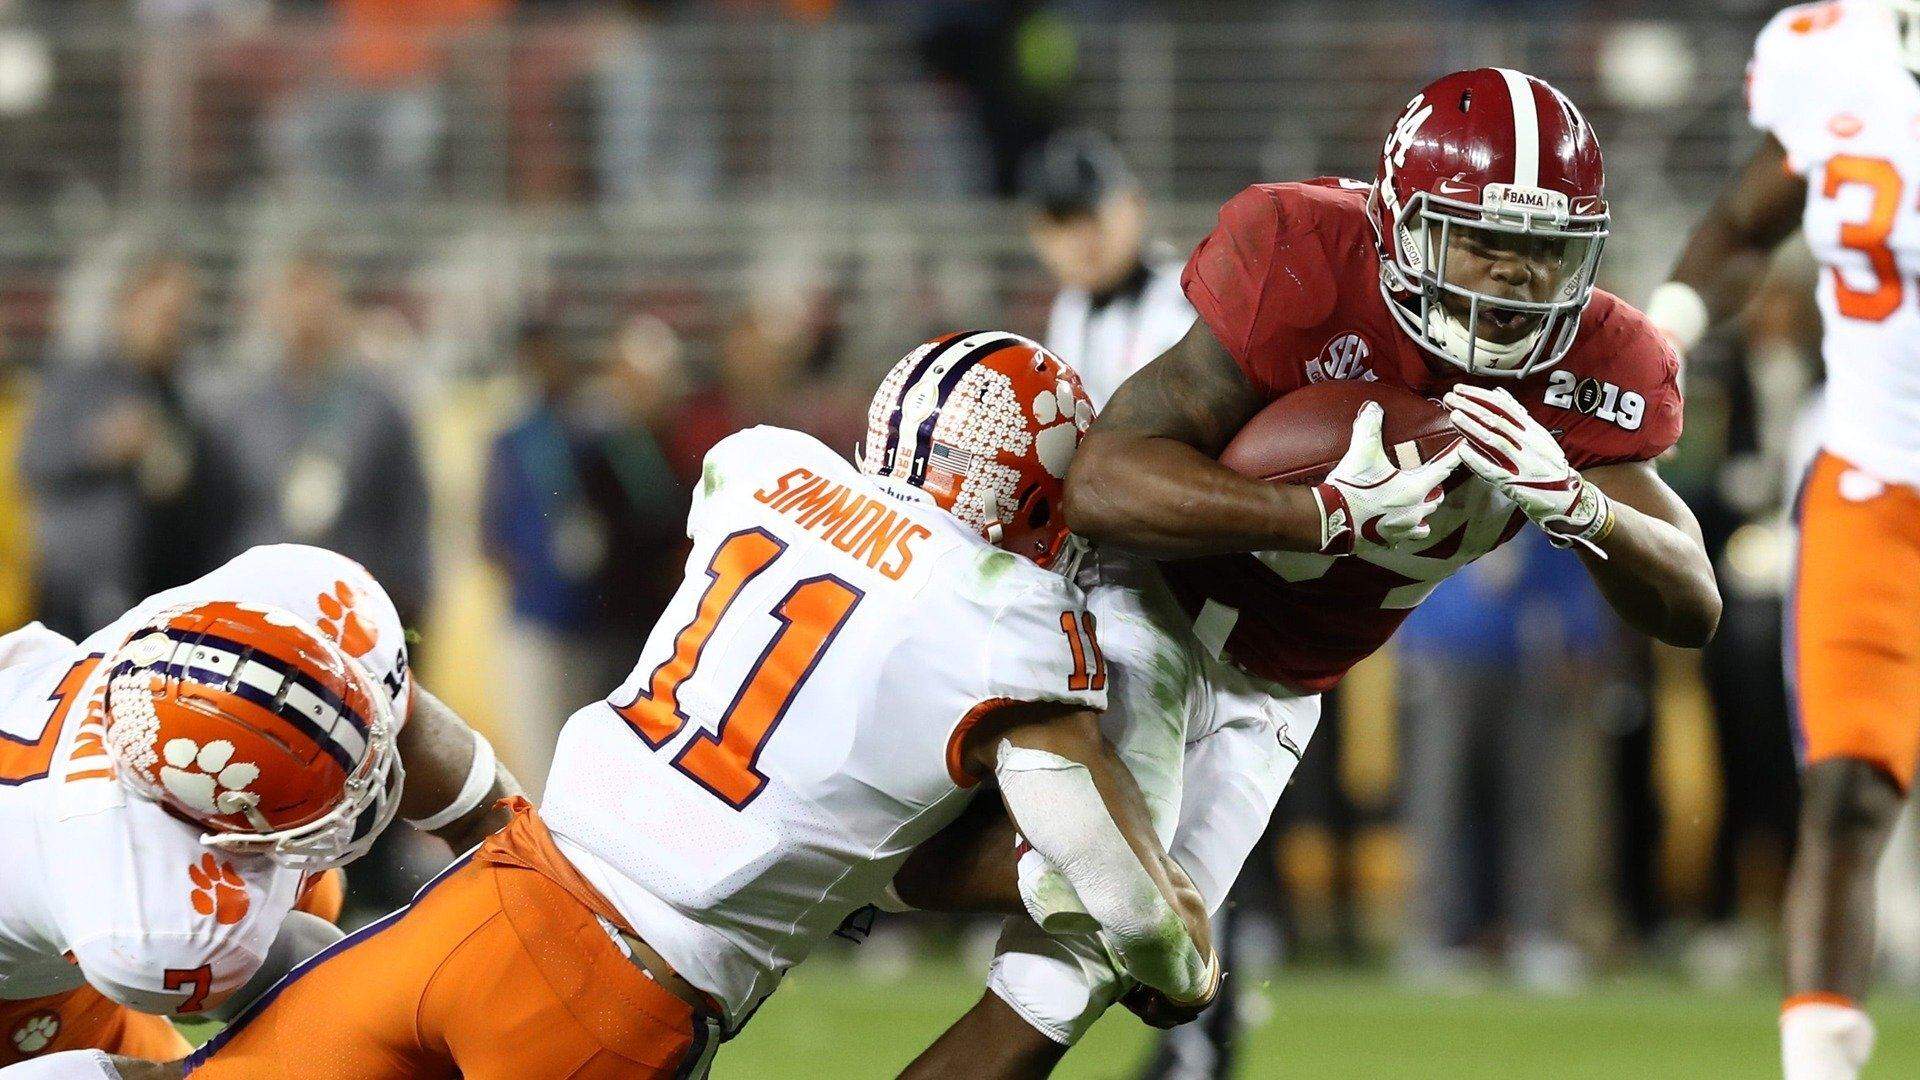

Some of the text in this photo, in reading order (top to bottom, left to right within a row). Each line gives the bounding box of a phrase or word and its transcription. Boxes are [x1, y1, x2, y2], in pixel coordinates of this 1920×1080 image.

[1383, 92, 1433, 168] 34
[1823, 153, 1920, 323] 3
[1324, 333, 1370, 380] SEC
[753, 468, 932, 581] SIMMONS
[608, 525, 866, 812] 11
[1060, 611, 1106, 691] 11
[163, 963, 213, 1014] 7
